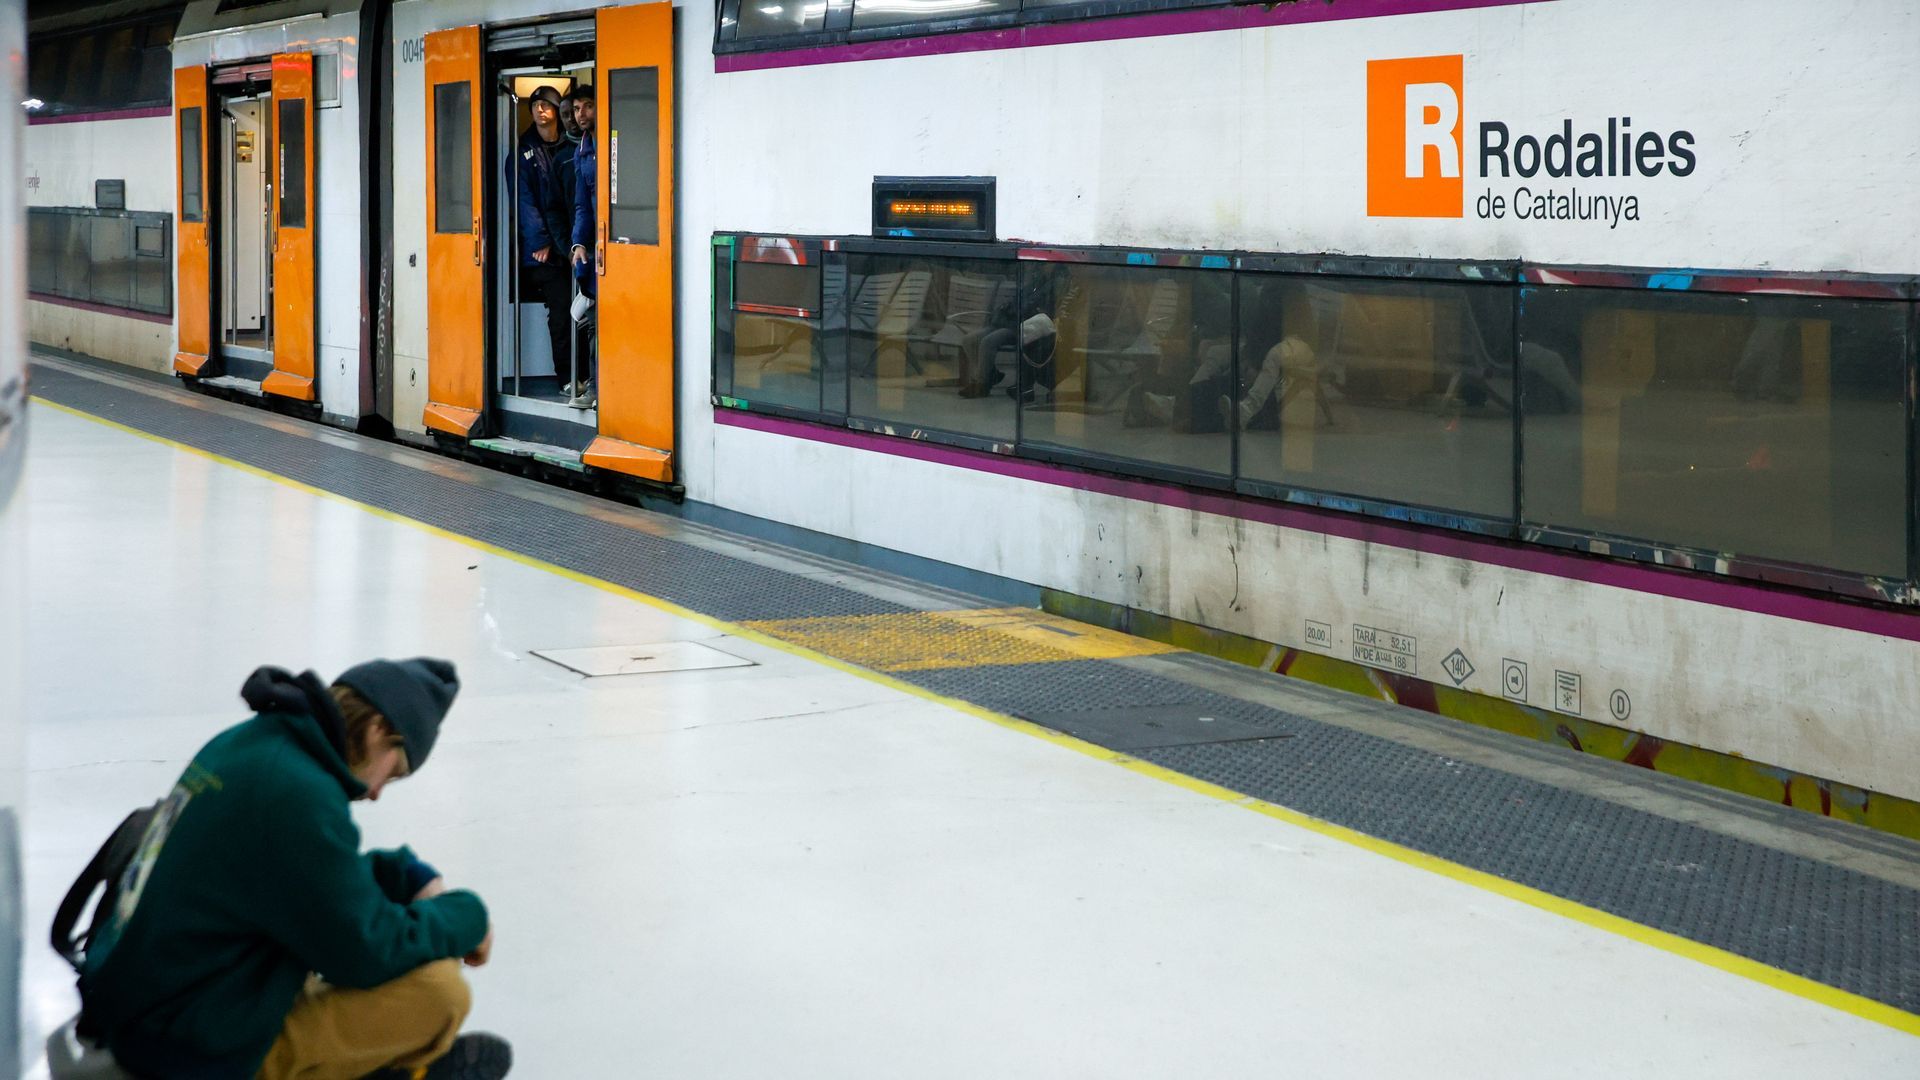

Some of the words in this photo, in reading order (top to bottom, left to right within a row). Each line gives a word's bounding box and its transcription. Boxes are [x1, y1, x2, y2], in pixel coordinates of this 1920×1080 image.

[1405, 82, 1460, 178] R
[1479, 117, 1697, 178] Rodalies
[1476, 187, 1506, 219] de
[1513, 187, 1640, 230] Catalunya
[1355, 628, 1376, 644] TARA
[1451, 657, 1466, 677] 140
[1617, 695, 1625, 714] D
